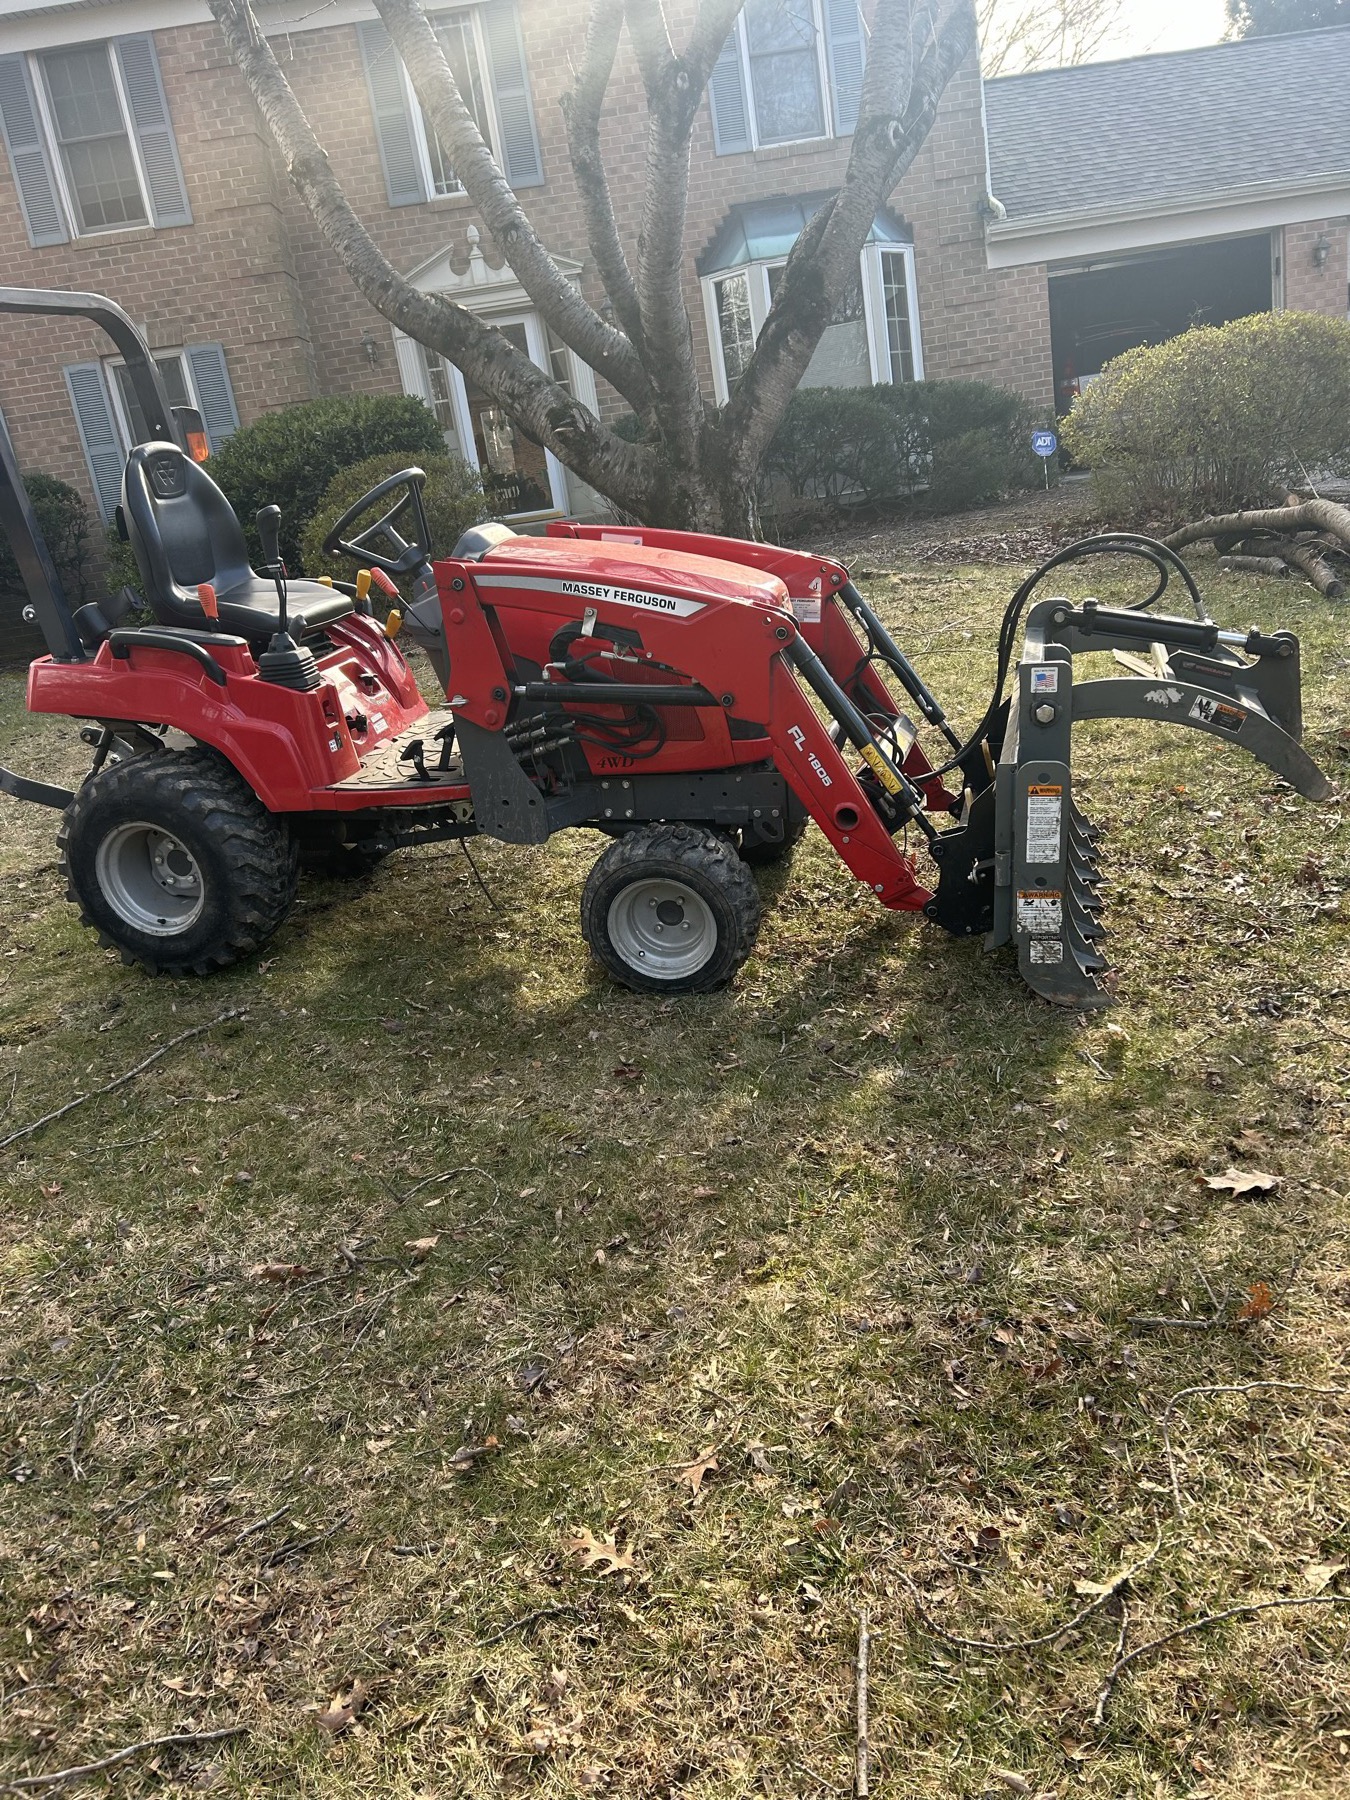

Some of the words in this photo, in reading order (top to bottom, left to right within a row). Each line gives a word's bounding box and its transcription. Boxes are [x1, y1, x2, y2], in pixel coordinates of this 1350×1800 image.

[1036, 436, 1052, 446] ADT
[562, 582, 610, 598] MASSEY
[613, 590, 676, 611] FERGUSON
[596, 756, 635, 768] 4WD
[787, 725, 806, 752] FL
[808, 752, 833, 787] 1805
